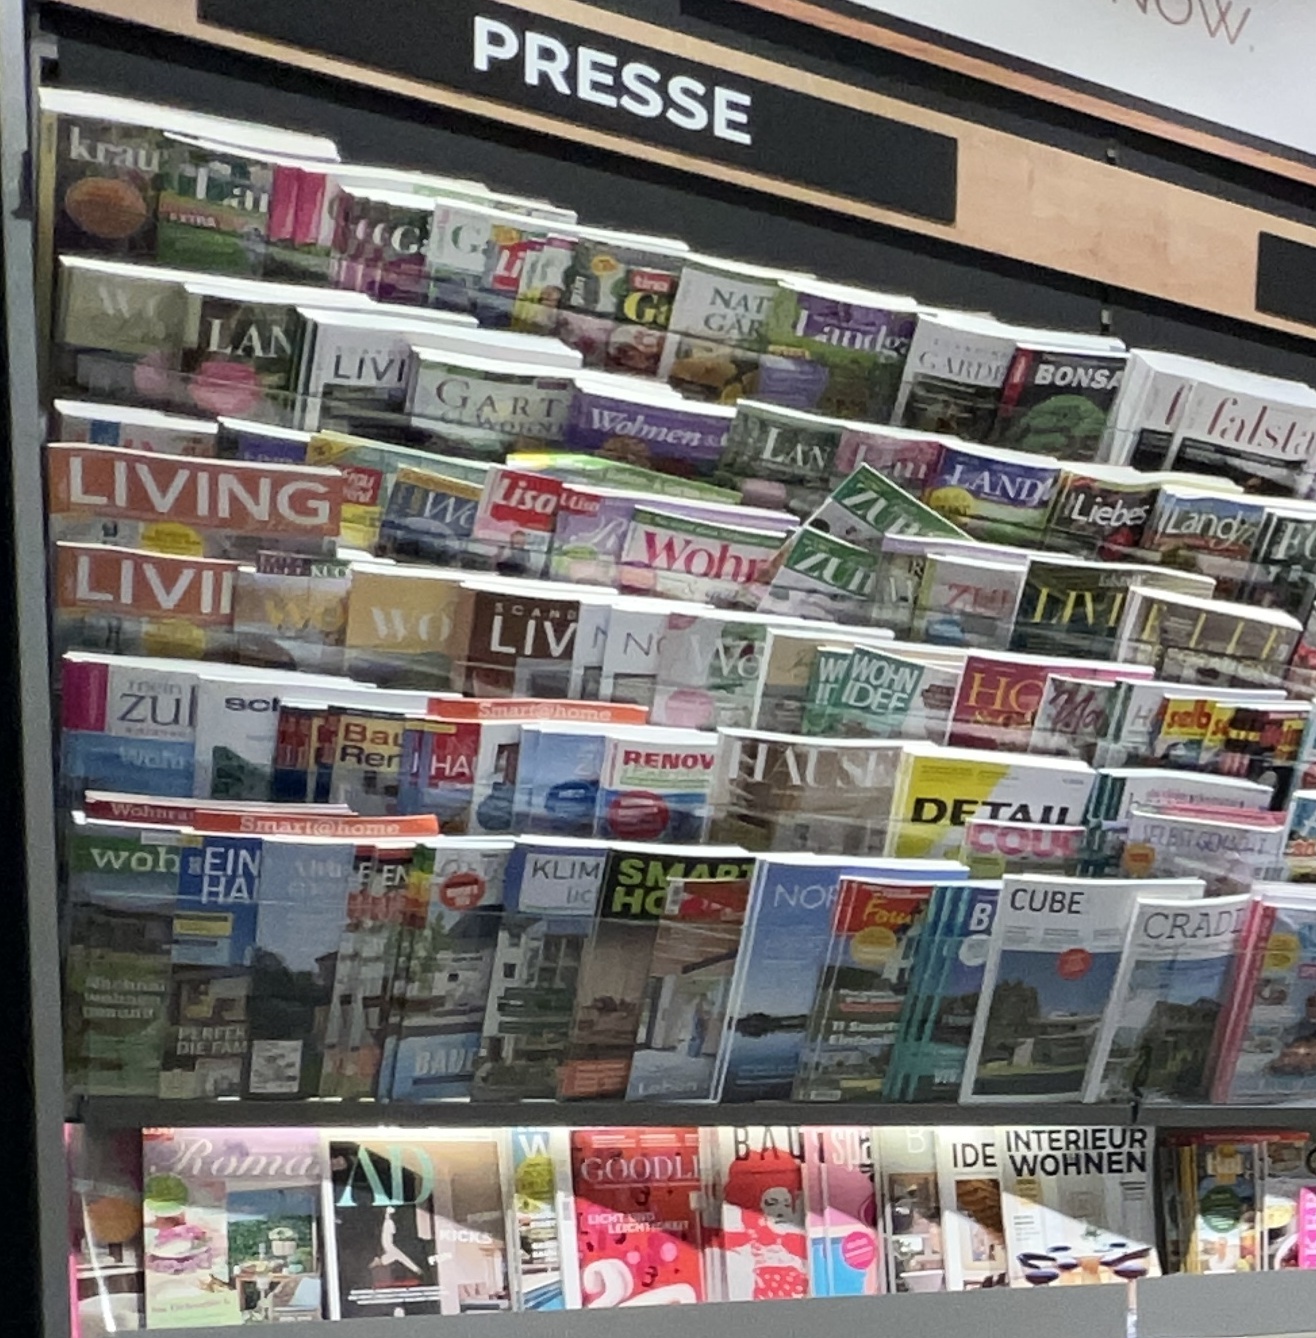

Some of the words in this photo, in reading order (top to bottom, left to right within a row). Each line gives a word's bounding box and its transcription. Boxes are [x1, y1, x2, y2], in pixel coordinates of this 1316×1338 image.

[473, 16, 752, 145] PRESSE
[69, 455, 330, 525] LIVING
[499, 470, 558, 513] Lisa
[852, 654, 920, 693] WOHN
[477, 702, 612, 723] Smart@home
[911, 796, 1069, 826] DETAIL
[239, 817, 399, 836] Smart@home
[1009, 888, 1084, 914] CUBE
[1005, 1128, 1147, 1153] INTERIEUR
[339, 1144, 437, 1208] AD
[1010, 1150, 1147, 1177] WOHNEN
